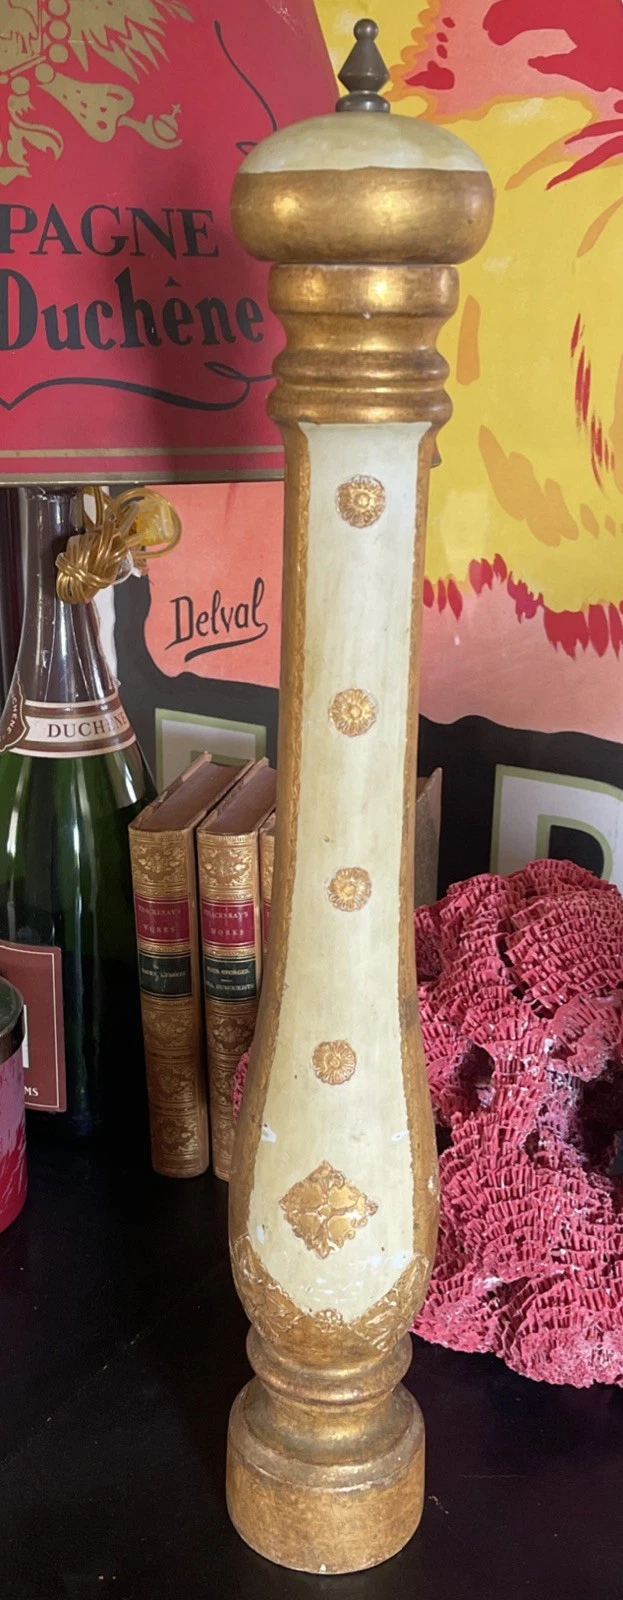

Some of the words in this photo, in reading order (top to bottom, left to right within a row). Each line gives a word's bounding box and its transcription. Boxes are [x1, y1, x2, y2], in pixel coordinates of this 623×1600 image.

[0, 267, 264, 351] Duchêne
[165, 577, 268, 652] Delval
[210, 928, 244, 937] WORKS
